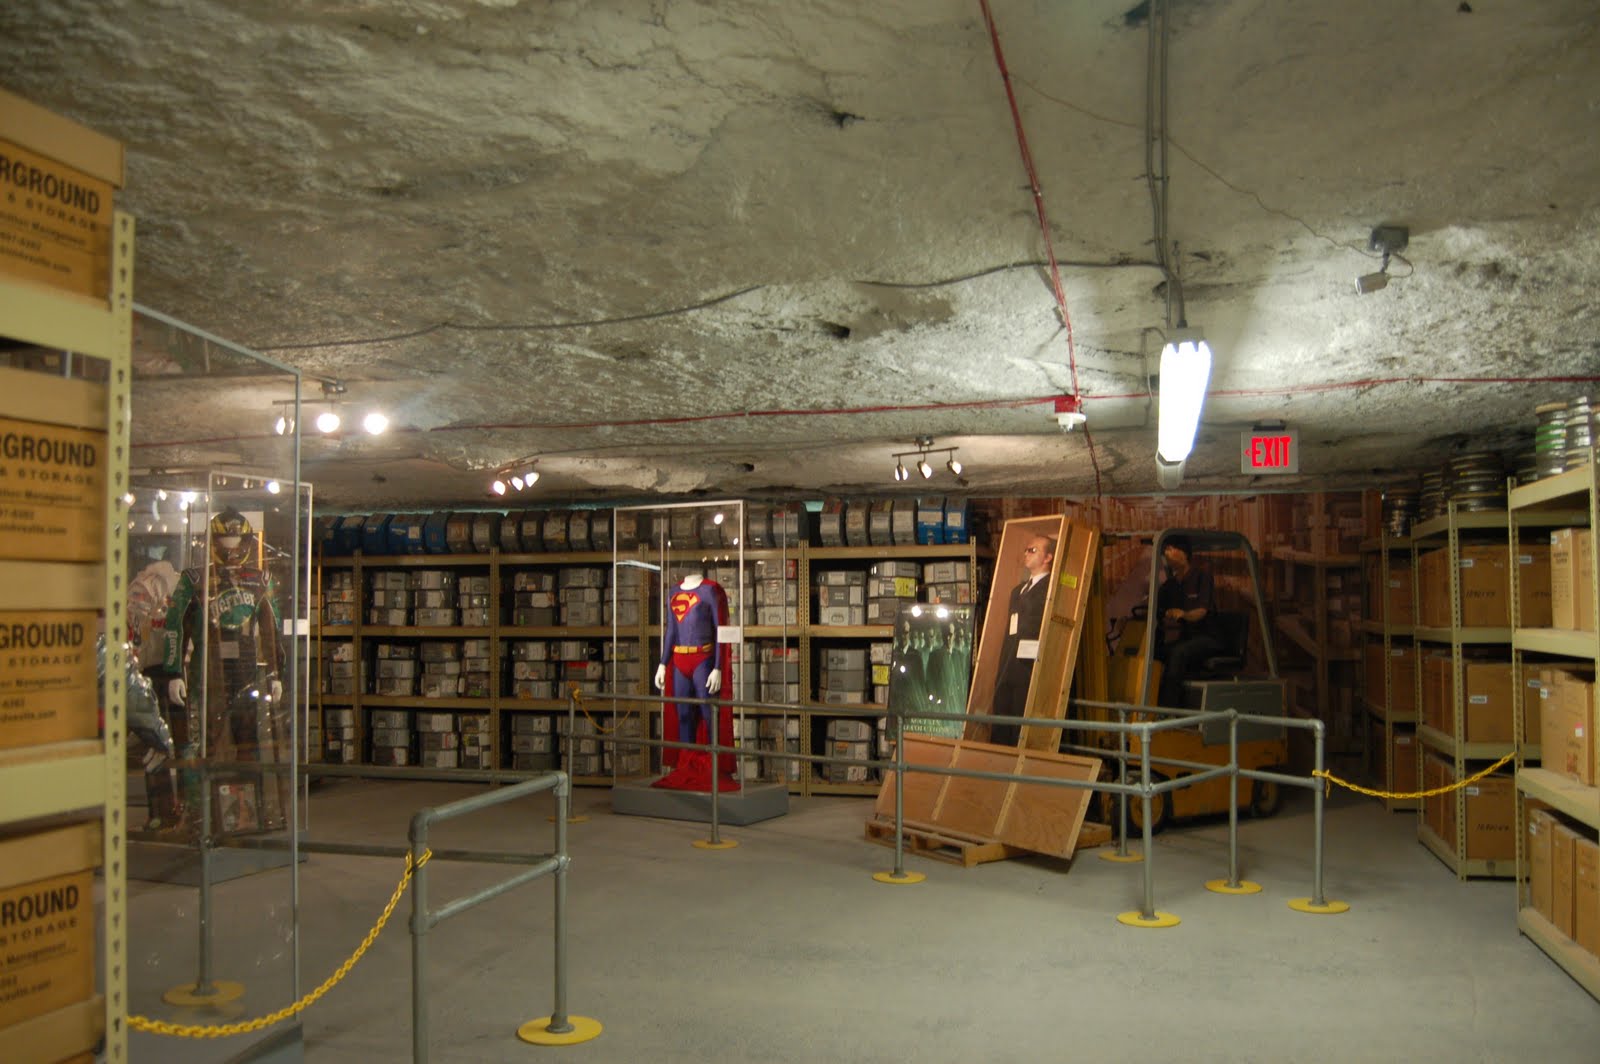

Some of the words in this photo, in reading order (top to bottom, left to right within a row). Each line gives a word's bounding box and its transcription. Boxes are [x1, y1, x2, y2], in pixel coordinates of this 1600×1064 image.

[25, 197, 98, 232] STORAGE
[0, 433, 96, 468] GROUND
[1251, 435, 1291, 468] EXIT
[18, 468, 94, 487] STORAGE
[8, 653, 82, 668] STORAGE
[1, 884, 79, 927] ROUND
